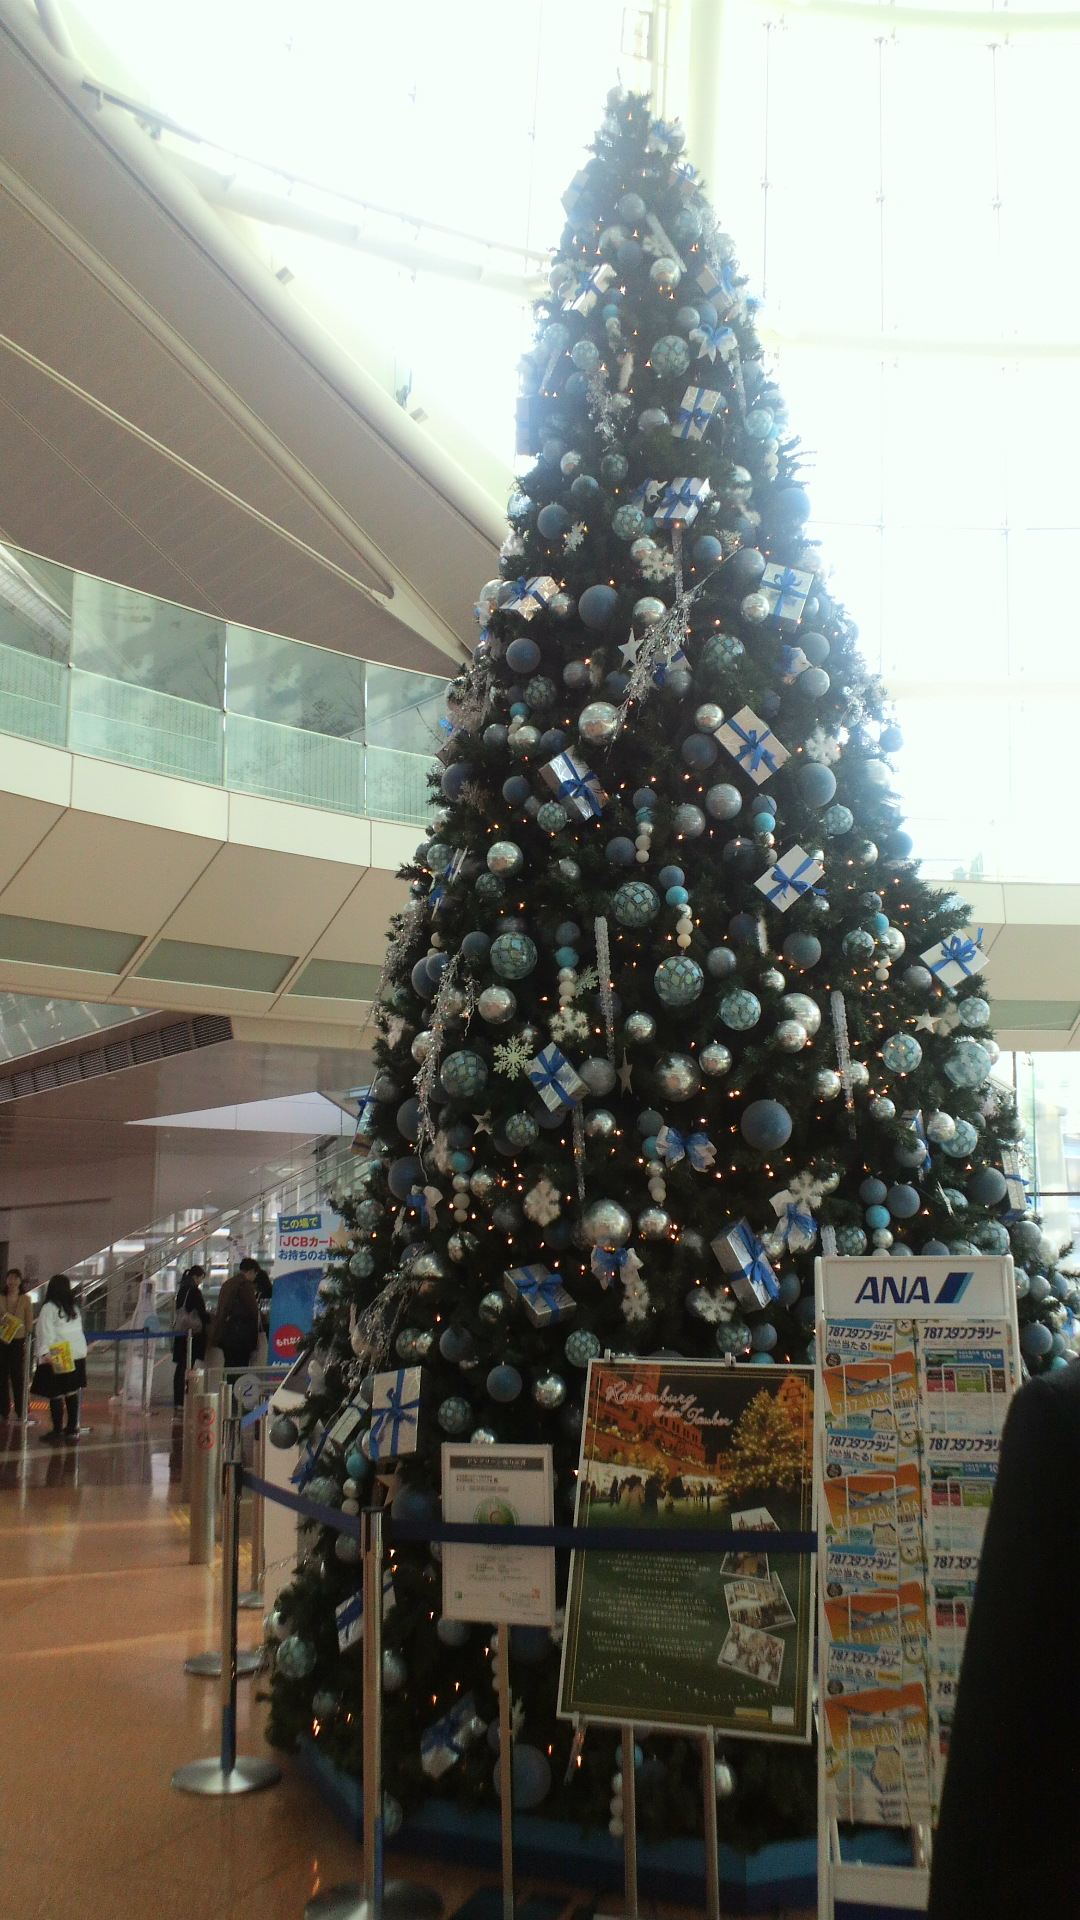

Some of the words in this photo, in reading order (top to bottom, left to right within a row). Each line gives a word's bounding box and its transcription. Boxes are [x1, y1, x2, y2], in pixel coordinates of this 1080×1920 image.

[281, 1217, 318, 1229] この場で
[854, 1276, 931, 1304] ANA
[923, 1326, 1002, 1340] 787スタンプラリー
